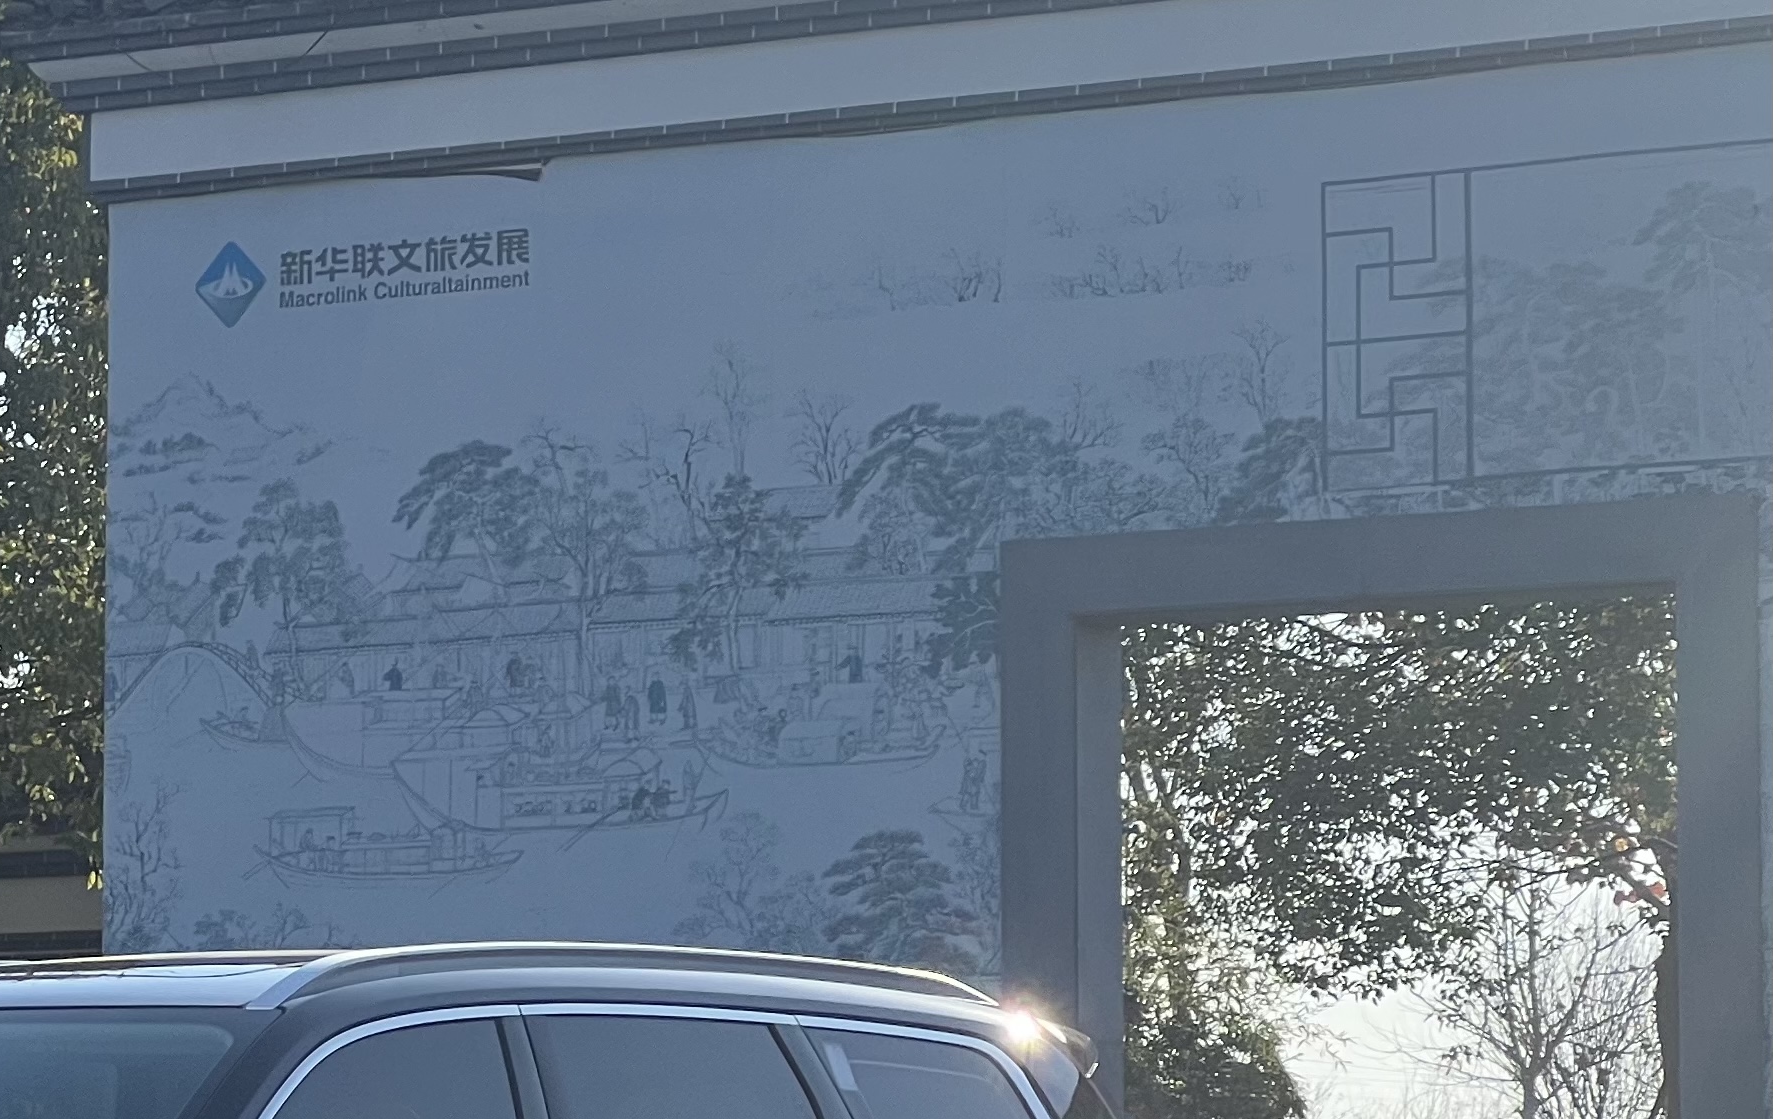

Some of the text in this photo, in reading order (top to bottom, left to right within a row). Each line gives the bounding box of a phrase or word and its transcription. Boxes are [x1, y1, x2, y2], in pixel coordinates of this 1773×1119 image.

[279, 228, 530, 286] 新华联文旅发展
[279, 269, 530, 309] Macrolink Culturaltainment
